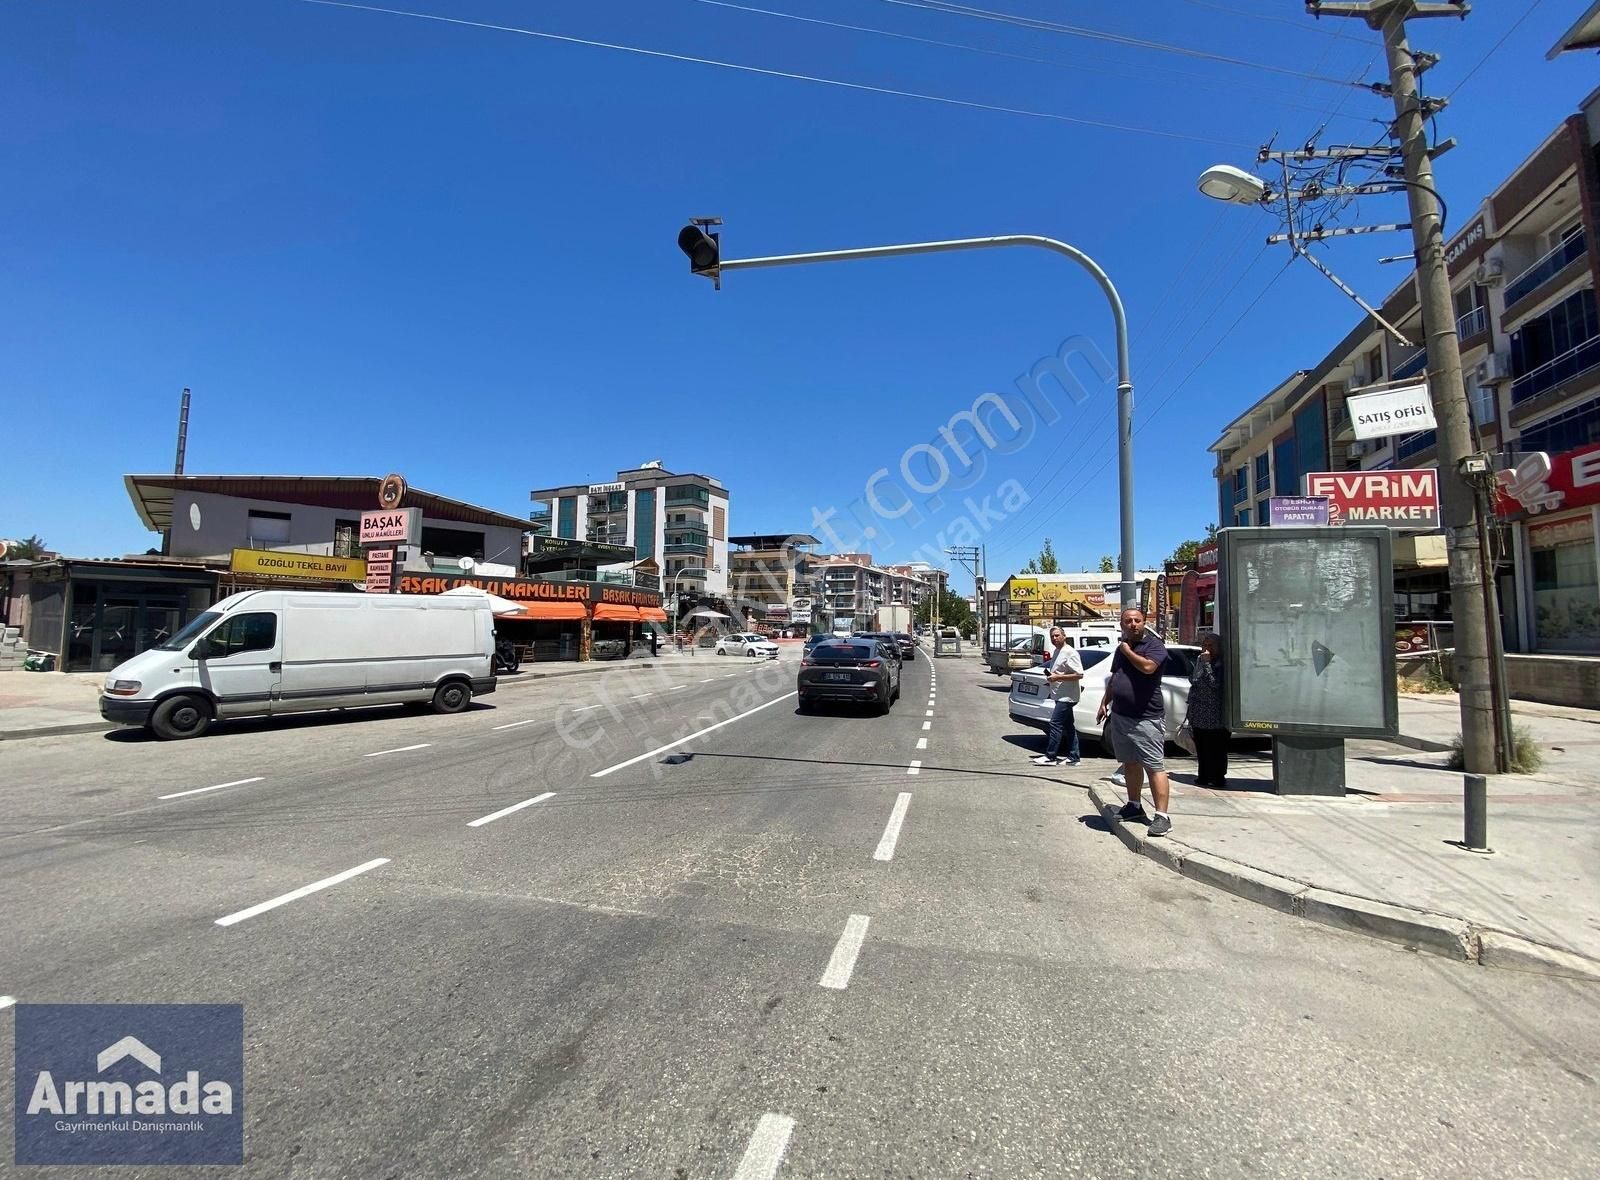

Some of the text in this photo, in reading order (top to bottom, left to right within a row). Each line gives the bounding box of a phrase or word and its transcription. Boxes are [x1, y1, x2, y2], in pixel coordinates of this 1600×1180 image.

[1358, 403, 1427, 426] SATIŞ OFİSİ
[1283, 513, 1315, 521] PAPATYA
[1349, 506, 1434, 520] MARKET
[363, 515, 403, 530] BAŞAK
[296, 561, 324, 571] TEKEL
[501, 582, 590, 601] MAMÜLLERİ
